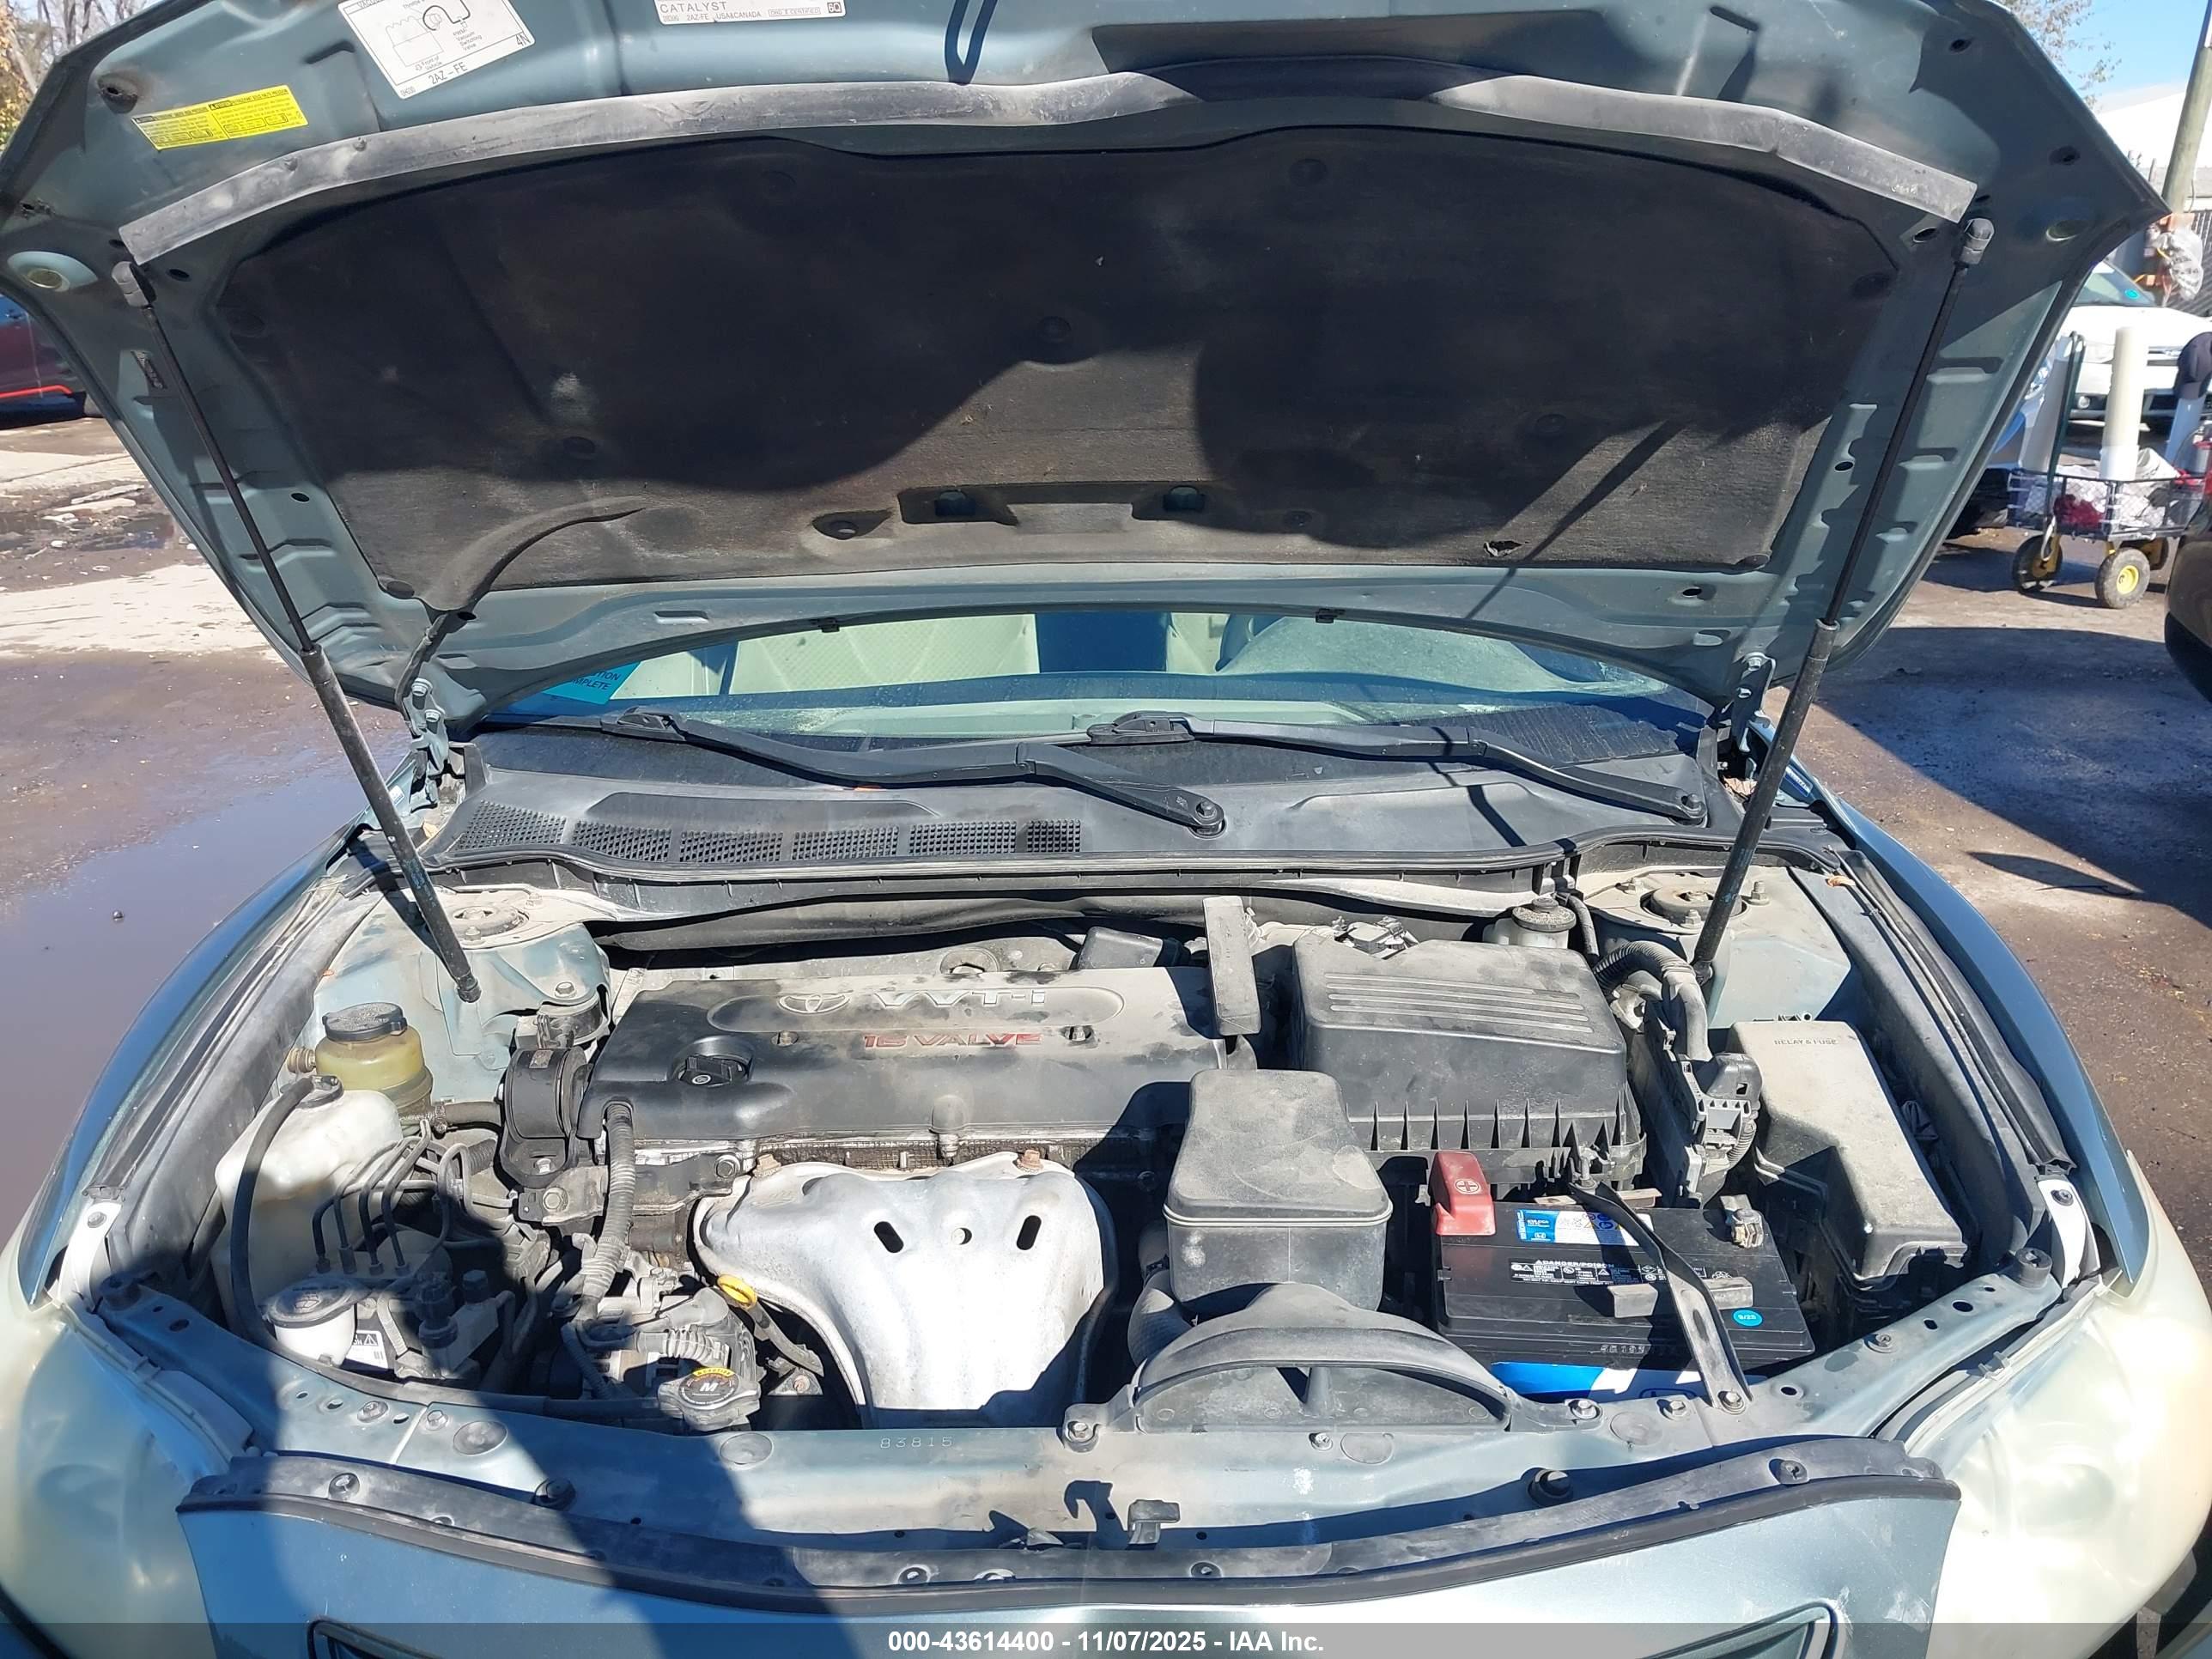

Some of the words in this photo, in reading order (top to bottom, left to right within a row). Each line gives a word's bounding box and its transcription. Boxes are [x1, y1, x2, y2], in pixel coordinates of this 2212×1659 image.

[660, 2, 726, 13] CATALYST
[596, 672, 621, 681] TION
[572, 678, 611, 690] MPLETE
[914, 1033, 1043, 1048] VALVE
[880, 1437, 952, 1449] 83815
